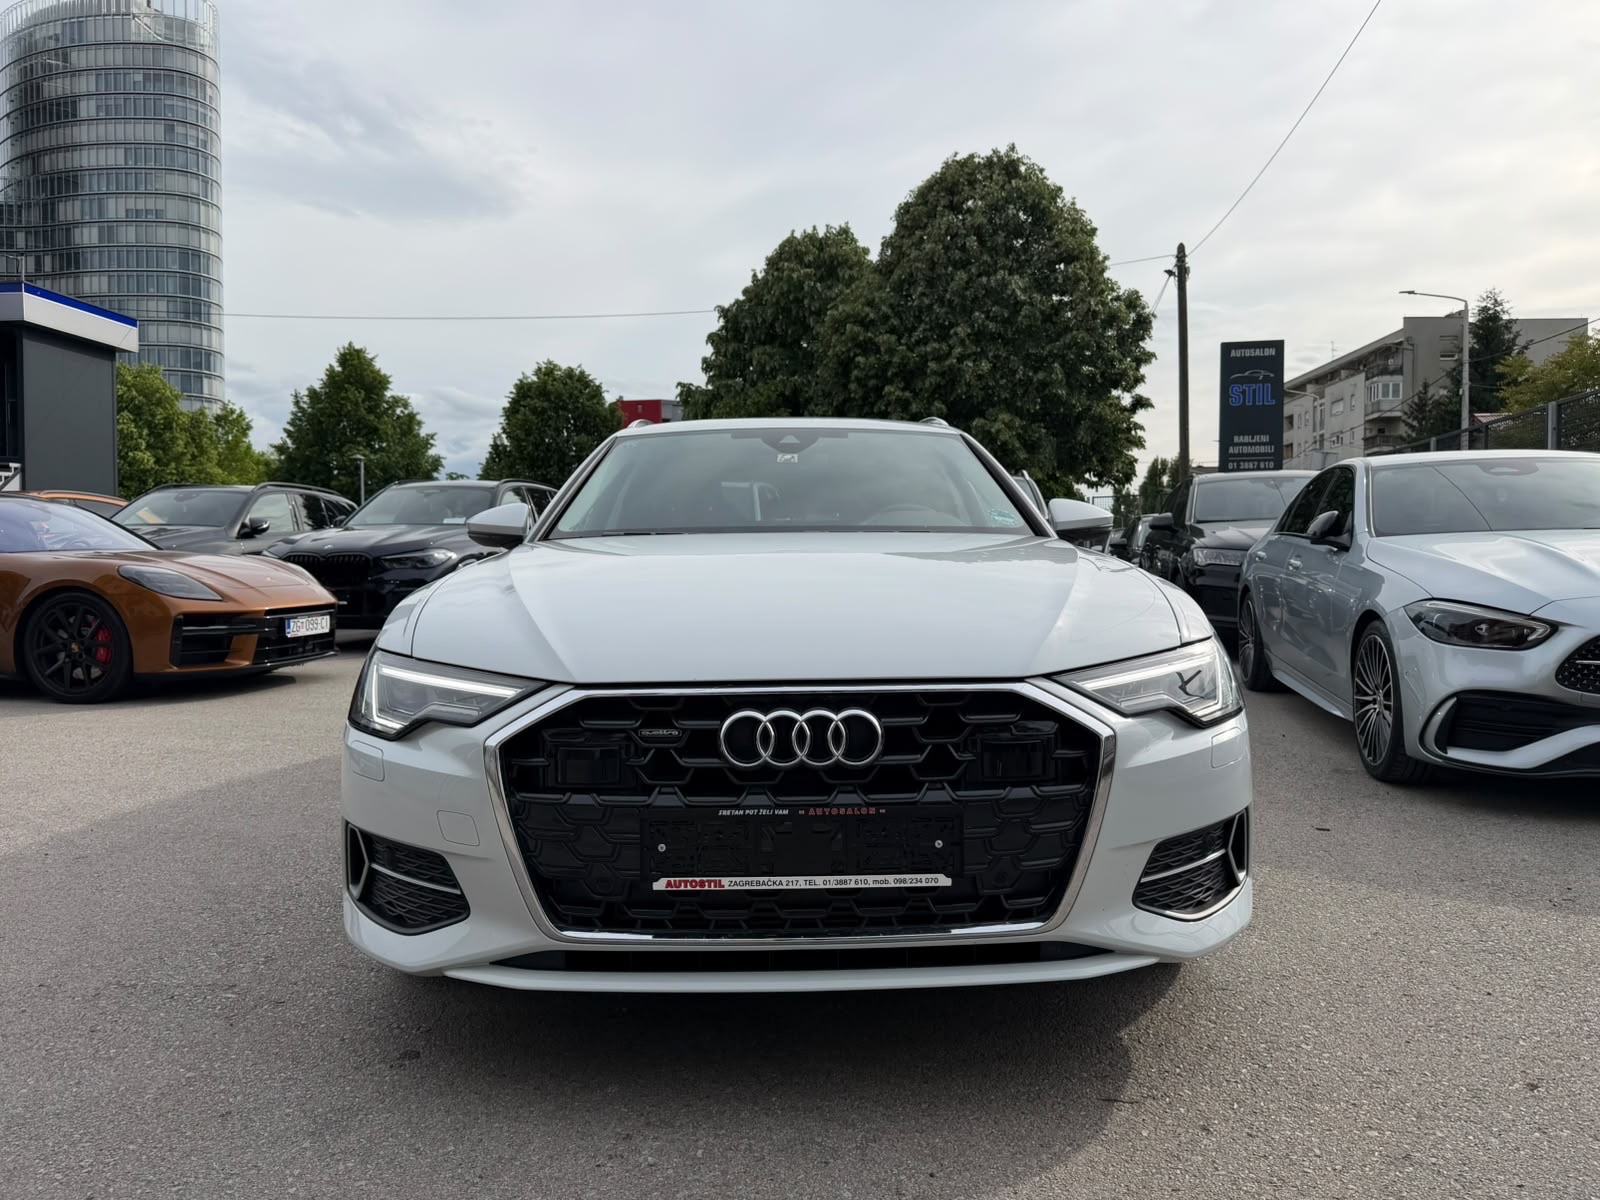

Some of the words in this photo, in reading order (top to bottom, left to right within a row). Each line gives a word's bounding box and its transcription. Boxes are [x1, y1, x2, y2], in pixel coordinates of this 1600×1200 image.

[1231, 348, 1276, 357] AUTOSALON
[1229, 383, 1276, 406] STIL
[1228, 445, 1275, 454] AUTOMOBILI
[1228, 462, 1237, 470] 01
[808, 807, 876, 816] AUTOSALON
[665, 879, 725, 888] AUTOSTIL
[728, 878, 784, 887] ZAGREBAČKA
[854, 878, 870, 886] 610,
